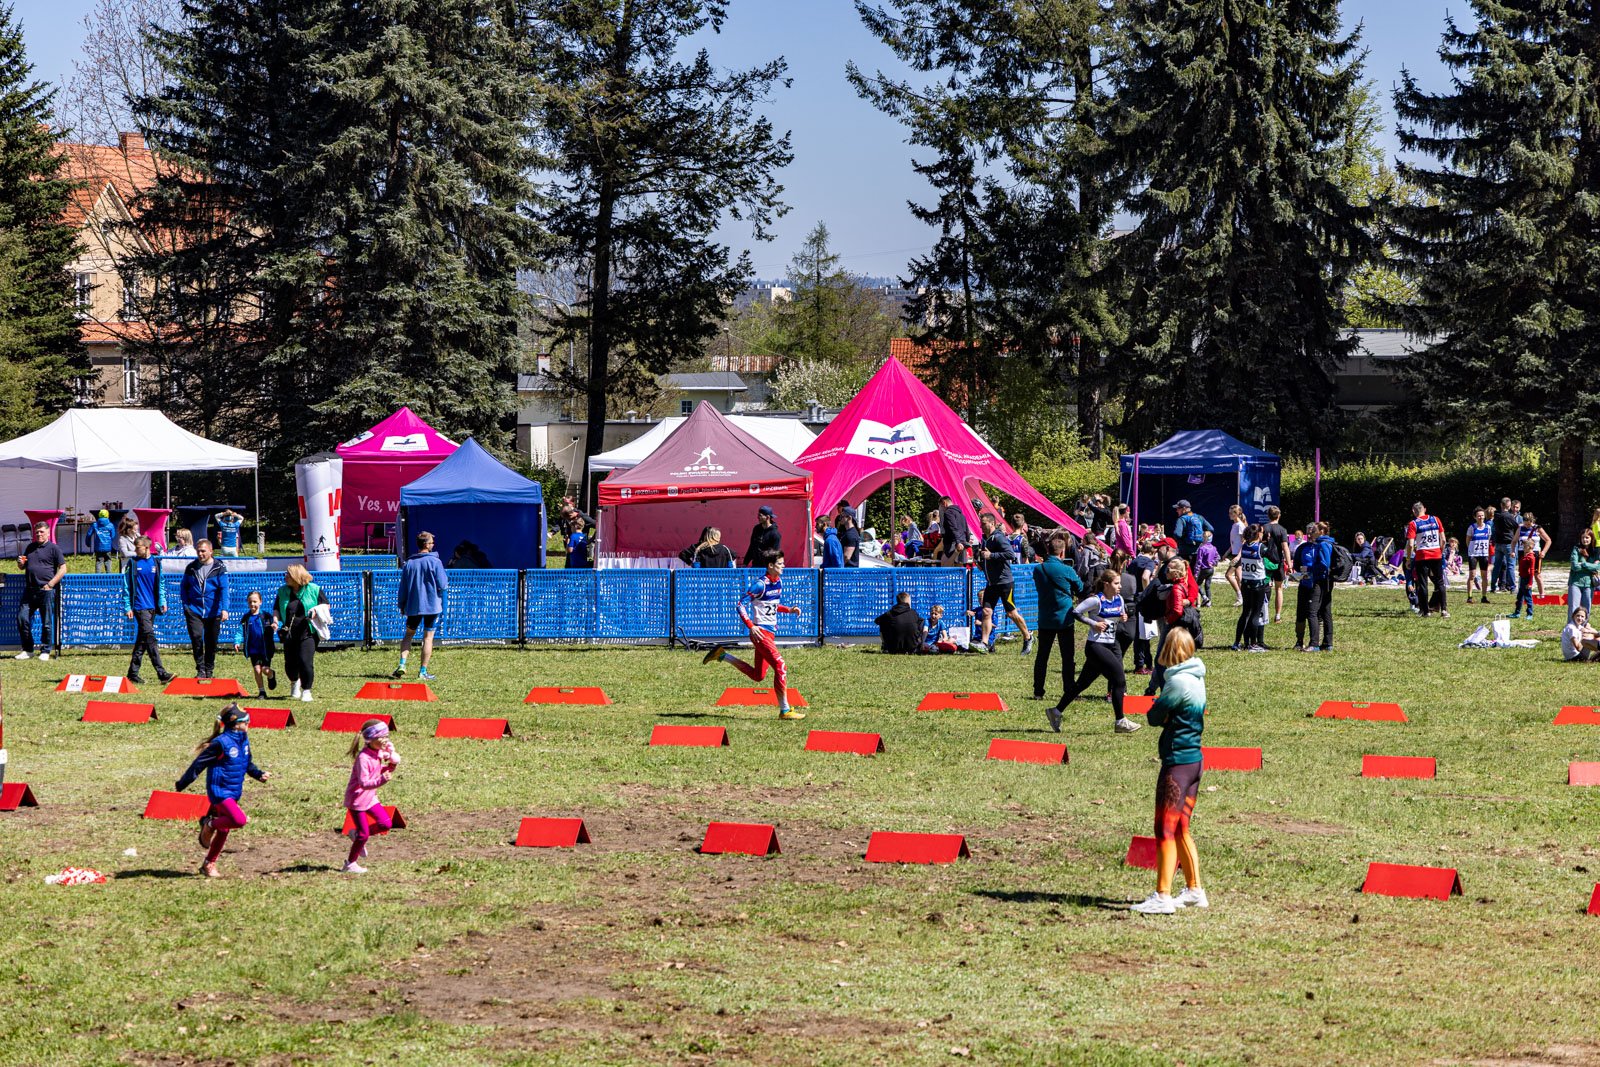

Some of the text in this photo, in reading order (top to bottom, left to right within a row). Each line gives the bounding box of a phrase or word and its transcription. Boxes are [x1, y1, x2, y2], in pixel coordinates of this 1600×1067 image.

[867, 446, 917, 455] KANS
[358, 495, 383, 513] Yes,
[1241, 563, 1257, 573] 260
